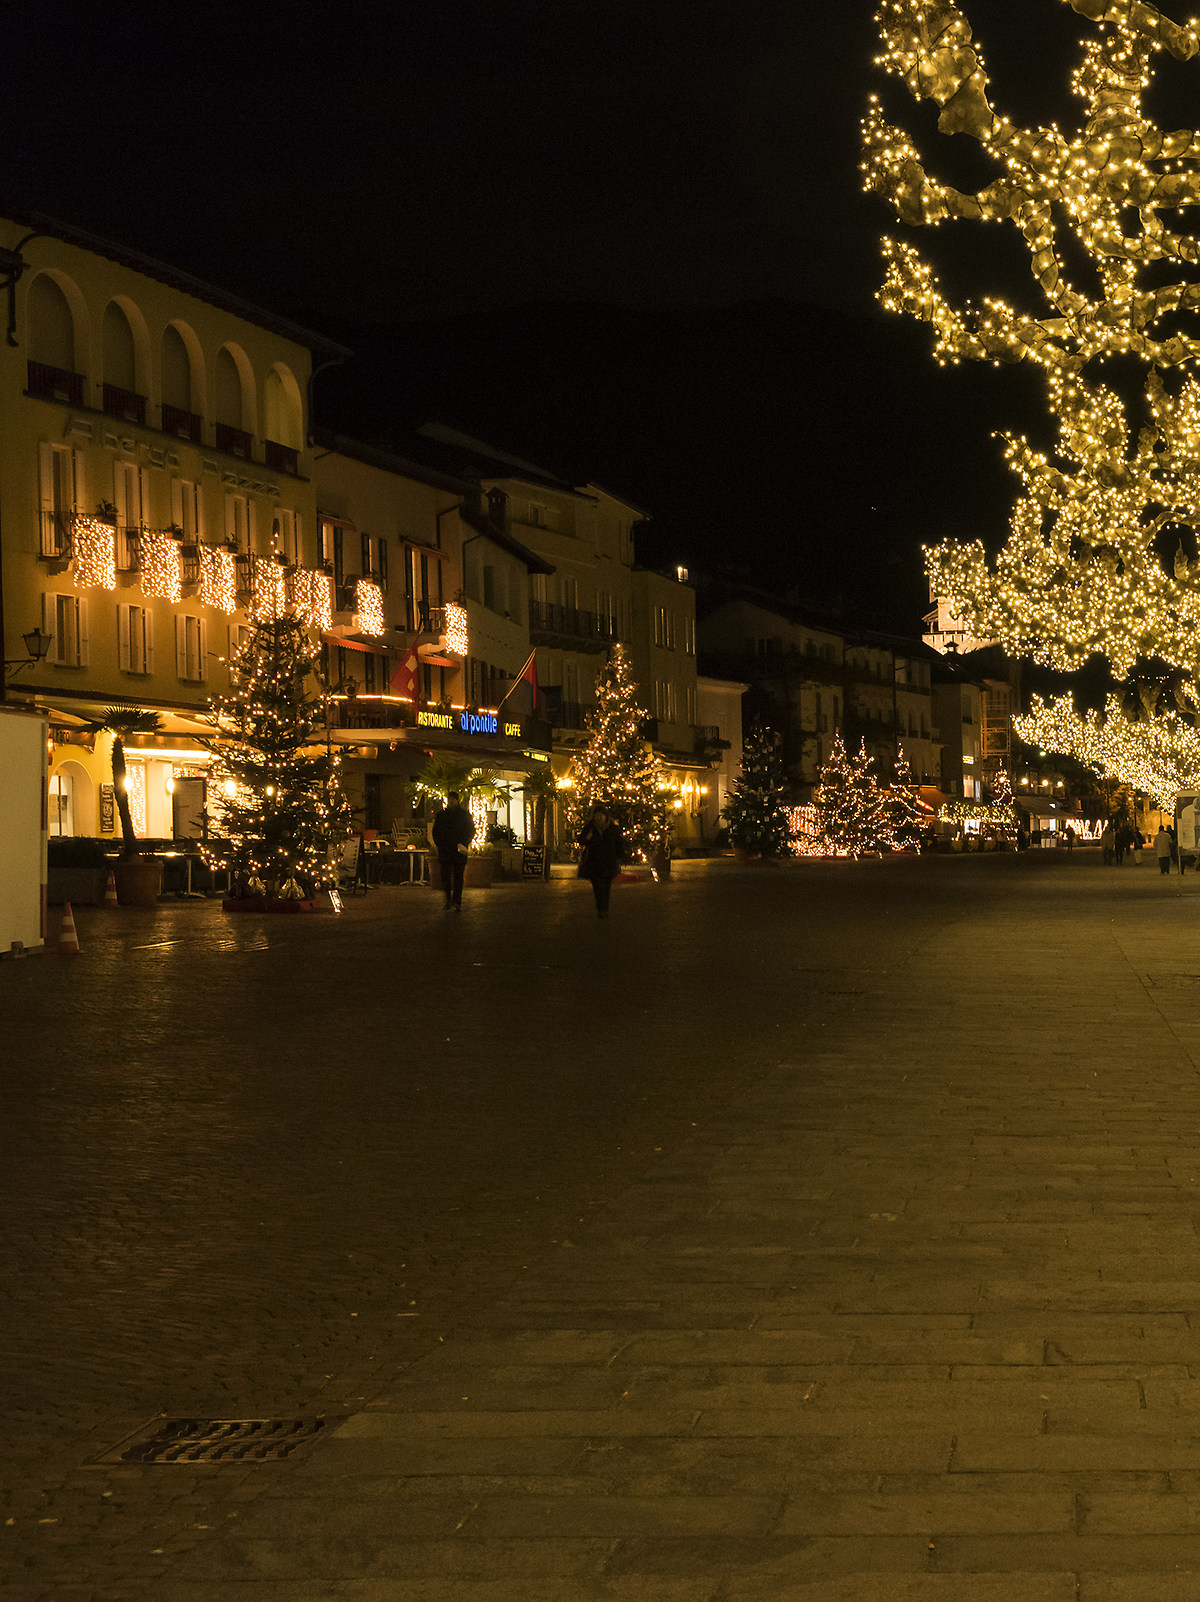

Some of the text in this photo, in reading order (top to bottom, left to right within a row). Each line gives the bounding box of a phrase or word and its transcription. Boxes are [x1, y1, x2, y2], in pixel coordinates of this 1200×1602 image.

[418, 711, 453, 730] RISTORANTE
[461, 711, 469, 731] al
[470, 713, 498, 735] pontile
